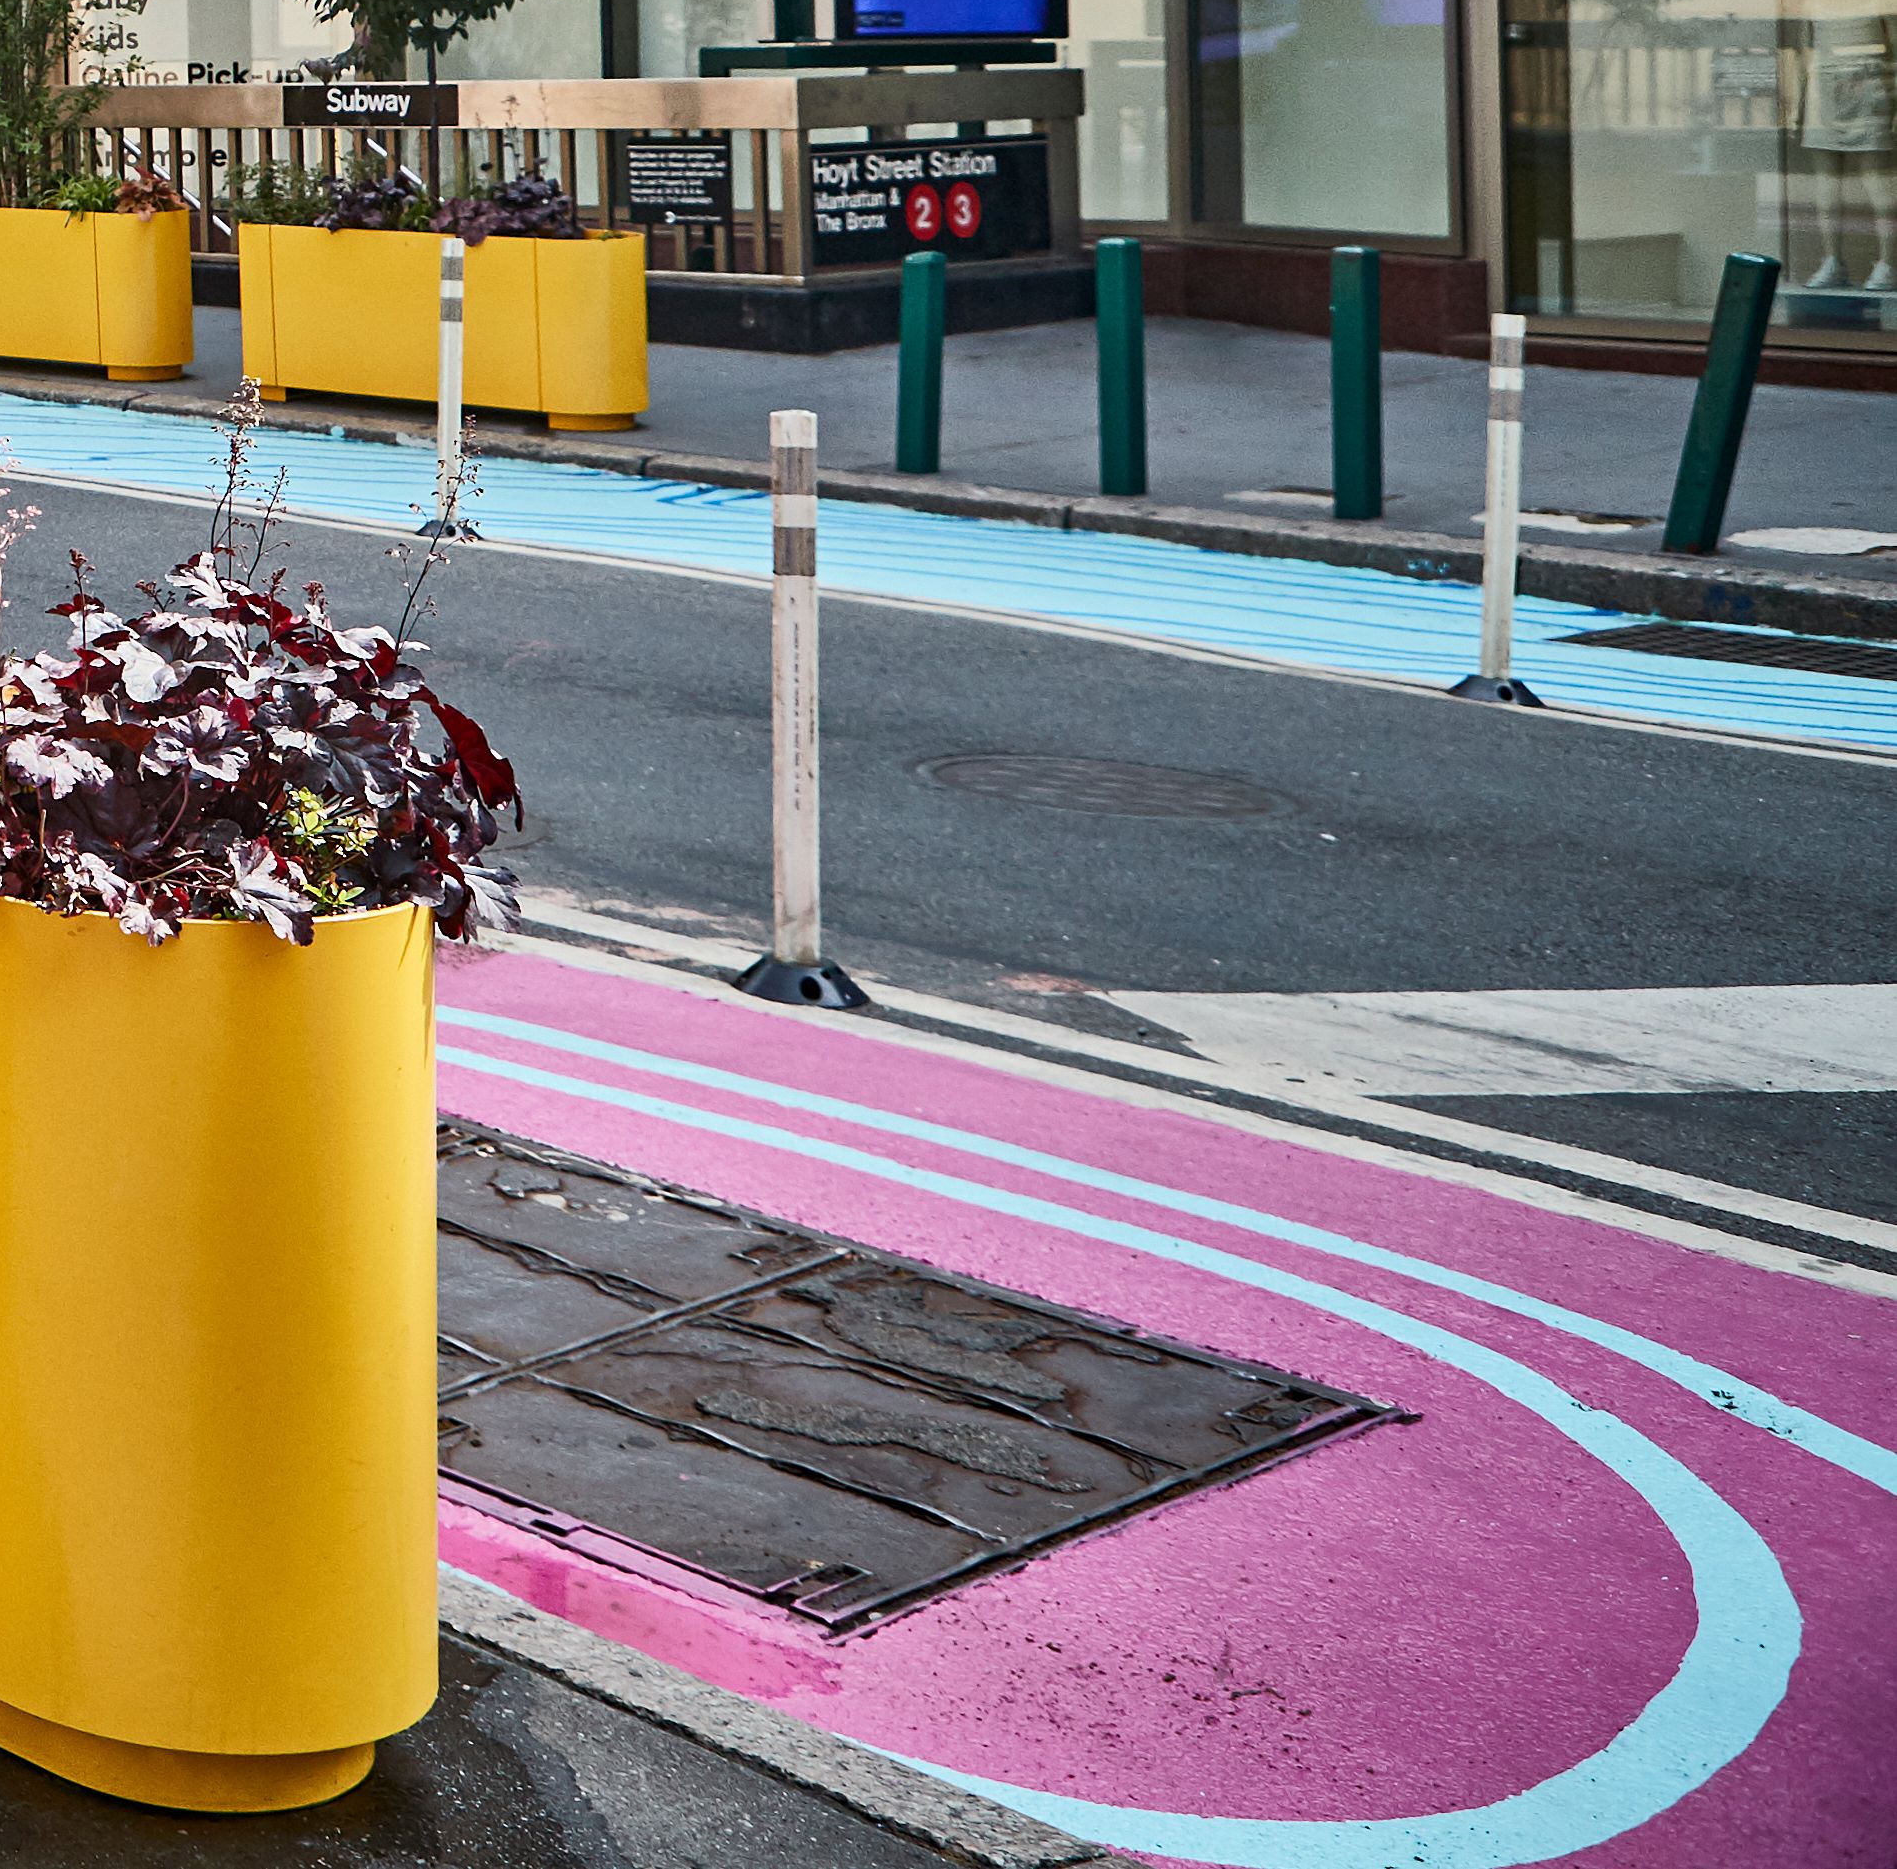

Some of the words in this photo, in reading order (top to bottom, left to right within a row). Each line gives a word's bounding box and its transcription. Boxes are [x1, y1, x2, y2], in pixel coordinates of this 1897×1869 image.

[326, 87, 411, 117] Subway
[812, 156, 860, 188] Hoyt
[864, 154, 924, 182] Street
[929, 151, 997, 178] Station
[815, 213, 843, 233] The
[845, 211, 888, 232] Bronx
[914, 197, 932, 230] 2
[954, 194, 972, 227] 3
